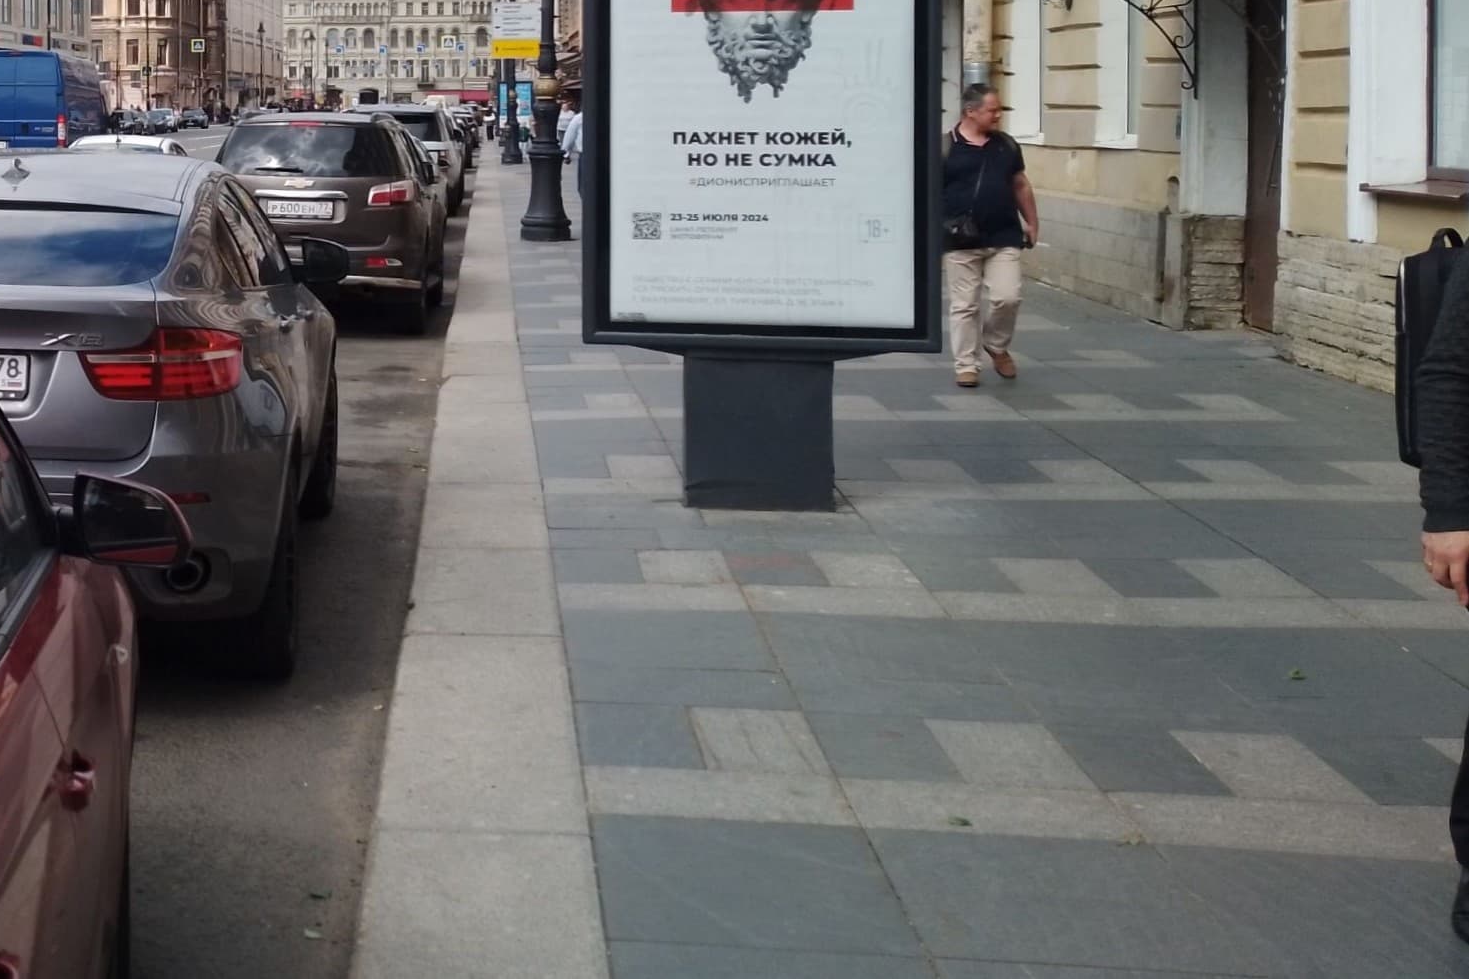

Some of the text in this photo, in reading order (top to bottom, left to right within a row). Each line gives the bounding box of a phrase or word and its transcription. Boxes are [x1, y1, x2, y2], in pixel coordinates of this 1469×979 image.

[672, 128, 853, 148] ПАХНЕТ КОЖЕЙ,
[687, 153, 837, 167] НО НЕ СУМКА
[689, 177, 836, 188] #ДИОНИСПРИГЛАШАЕТ
[670, 213, 769, 222] 23-25 ИЮЛЯ 2024
